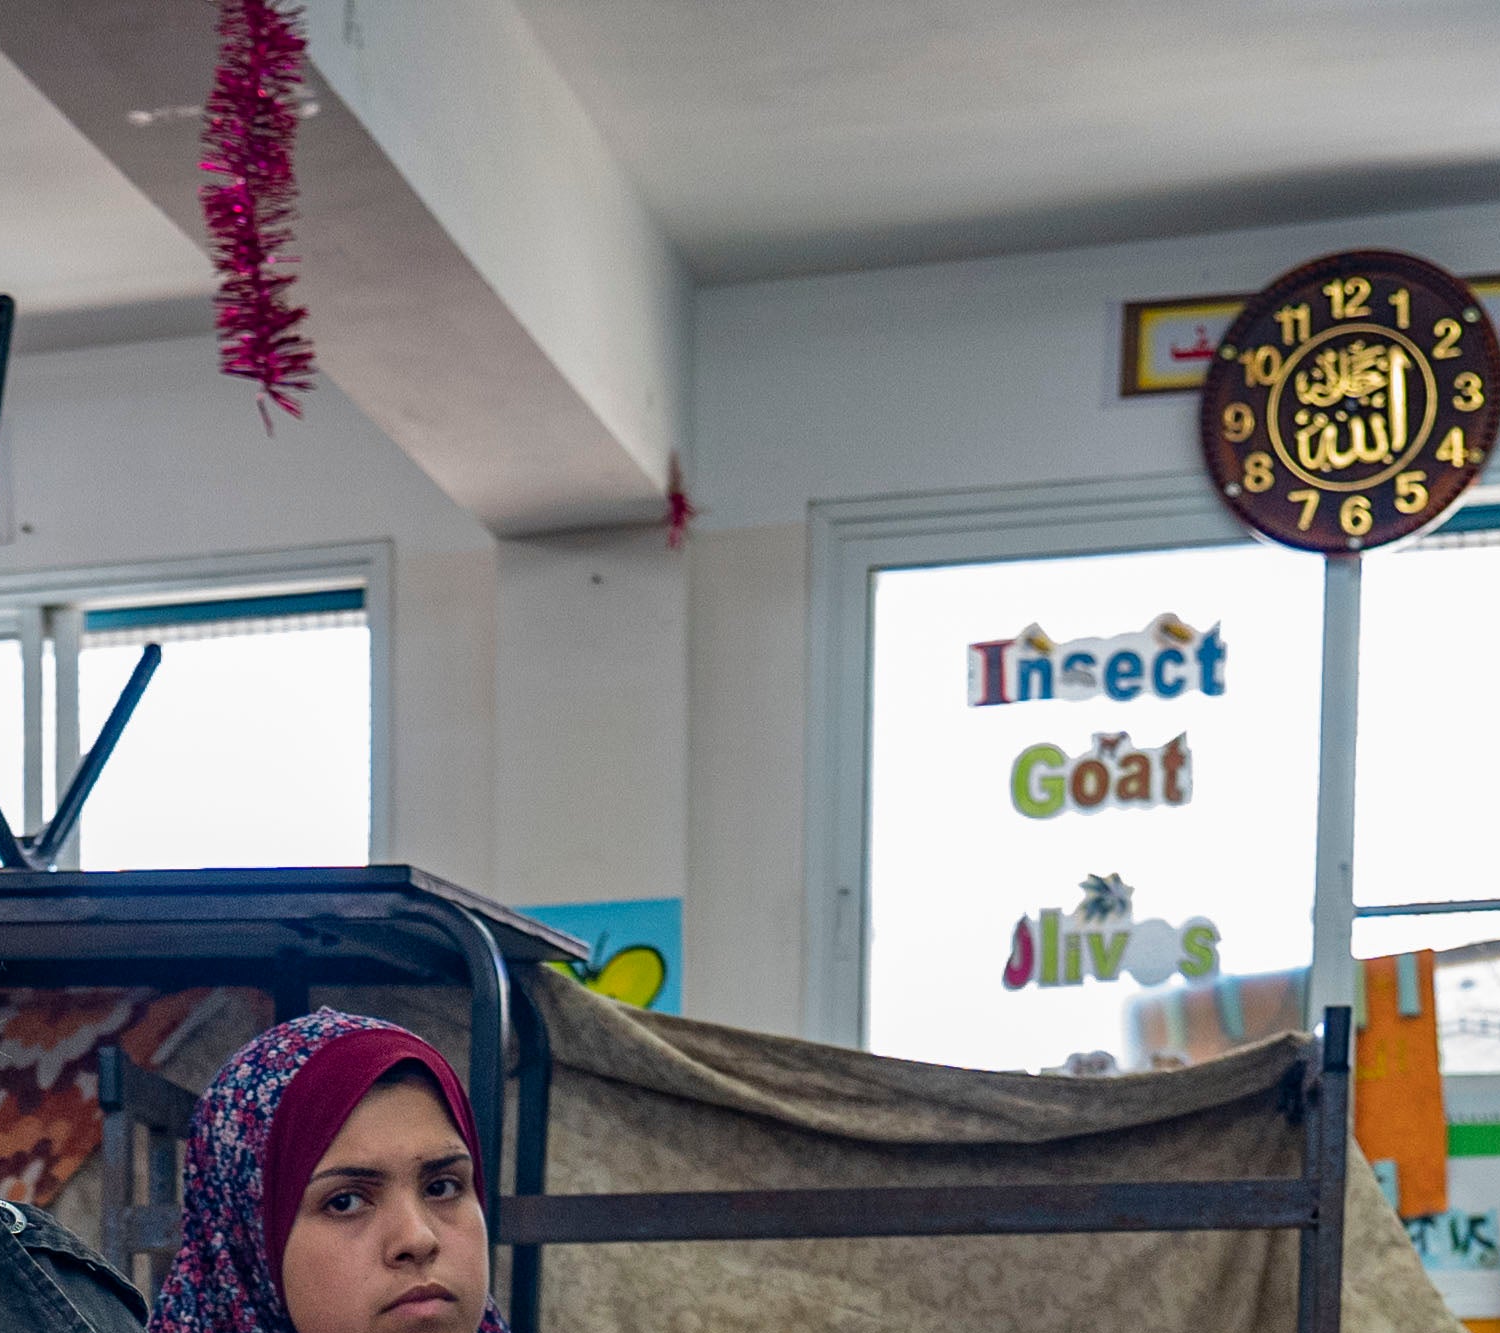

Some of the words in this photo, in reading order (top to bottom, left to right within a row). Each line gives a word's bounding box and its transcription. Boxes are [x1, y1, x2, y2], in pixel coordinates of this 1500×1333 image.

[1322, 277, 1371, 319] 12
[1388, 288, 1410, 330] 1
[1275, 302, 1312, 345] 11
[1432, 317, 1462, 360] 2
[1241, 342, 1284, 388] 10
[1453, 371, 1486, 412] 3
[1222, 402, 1255, 442] 9
[1435, 427, 1472, 468] 4
[1243, 450, 1275, 493] 8
[1394, 470, 1429, 514] 5
[1287, 489, 1320, 532] 7
[1340, 494, 1373, 536] 6
[972, 632, 1227, 706] Insect
[1012, 738, 1187, 816] Goat
